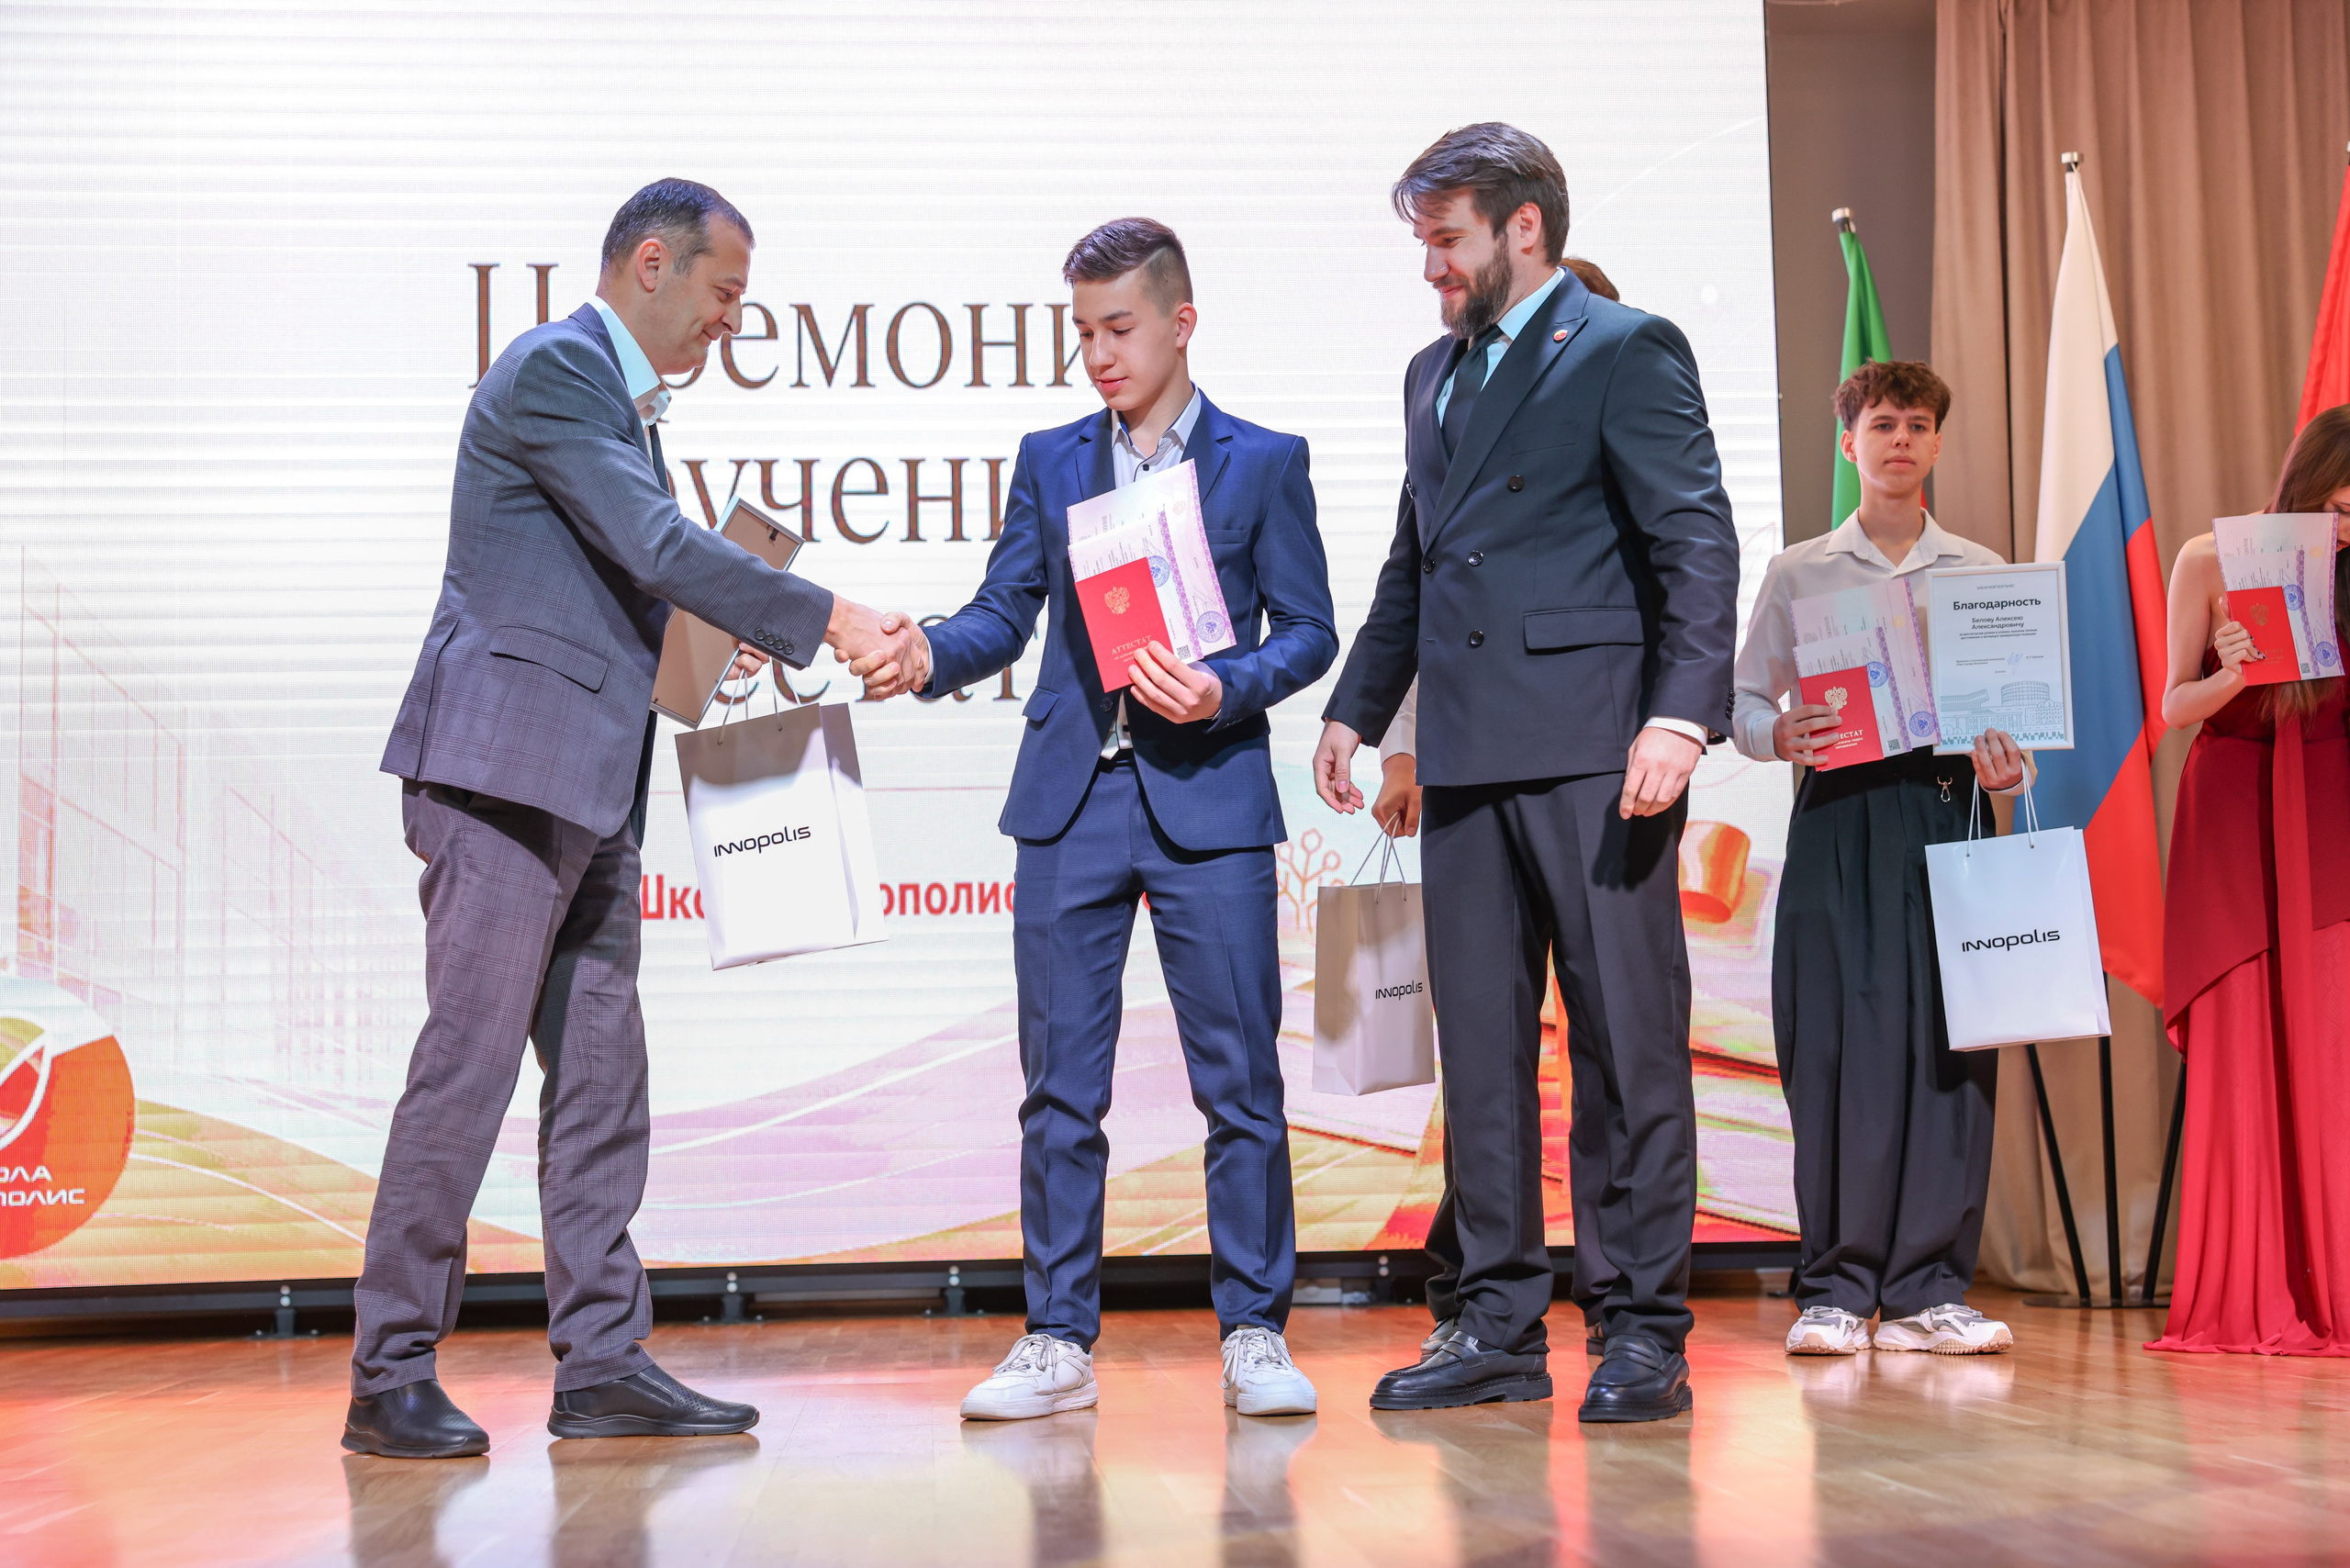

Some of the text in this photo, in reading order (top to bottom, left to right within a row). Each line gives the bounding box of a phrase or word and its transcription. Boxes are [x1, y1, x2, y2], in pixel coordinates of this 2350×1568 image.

[1953, 598, 2042, 610] Благодарность
[1971, 622, 2025, 631] Александровичу
[1111, 634, 1151, 655] АТТЕСТАТ
